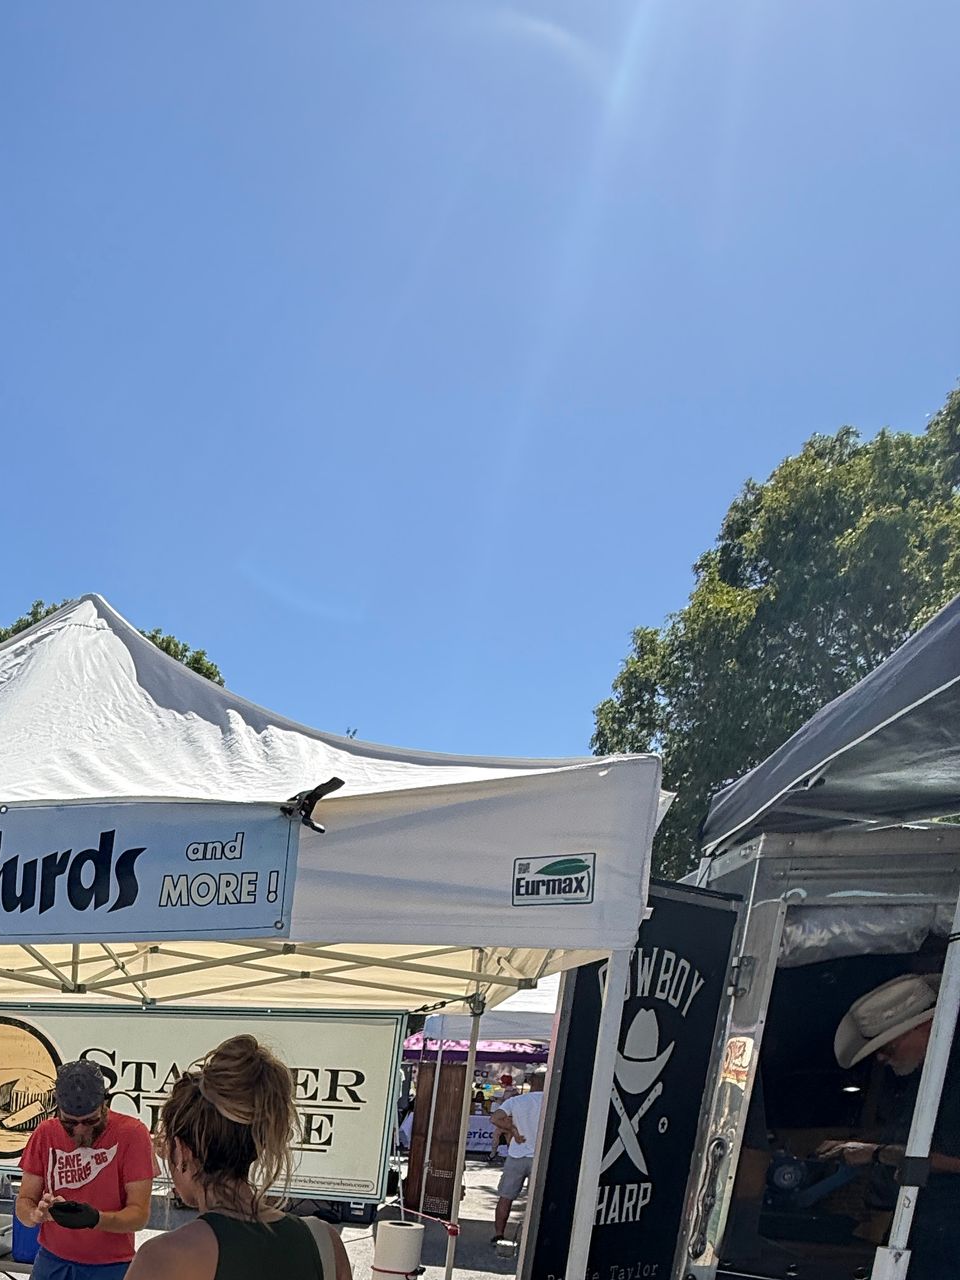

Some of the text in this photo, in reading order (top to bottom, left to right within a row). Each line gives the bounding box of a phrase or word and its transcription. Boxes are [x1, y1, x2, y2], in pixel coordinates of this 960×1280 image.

[186, 832, 244, 863] and
[159, 872, 257, 906] MORE
[516, 876, 585, 896] Eurmax
[58, 1152, 108, 1170] SAVE '86
[58, 1161, 91, 1185] FERRIS
[592, 1182, 652, 1225] HARP
